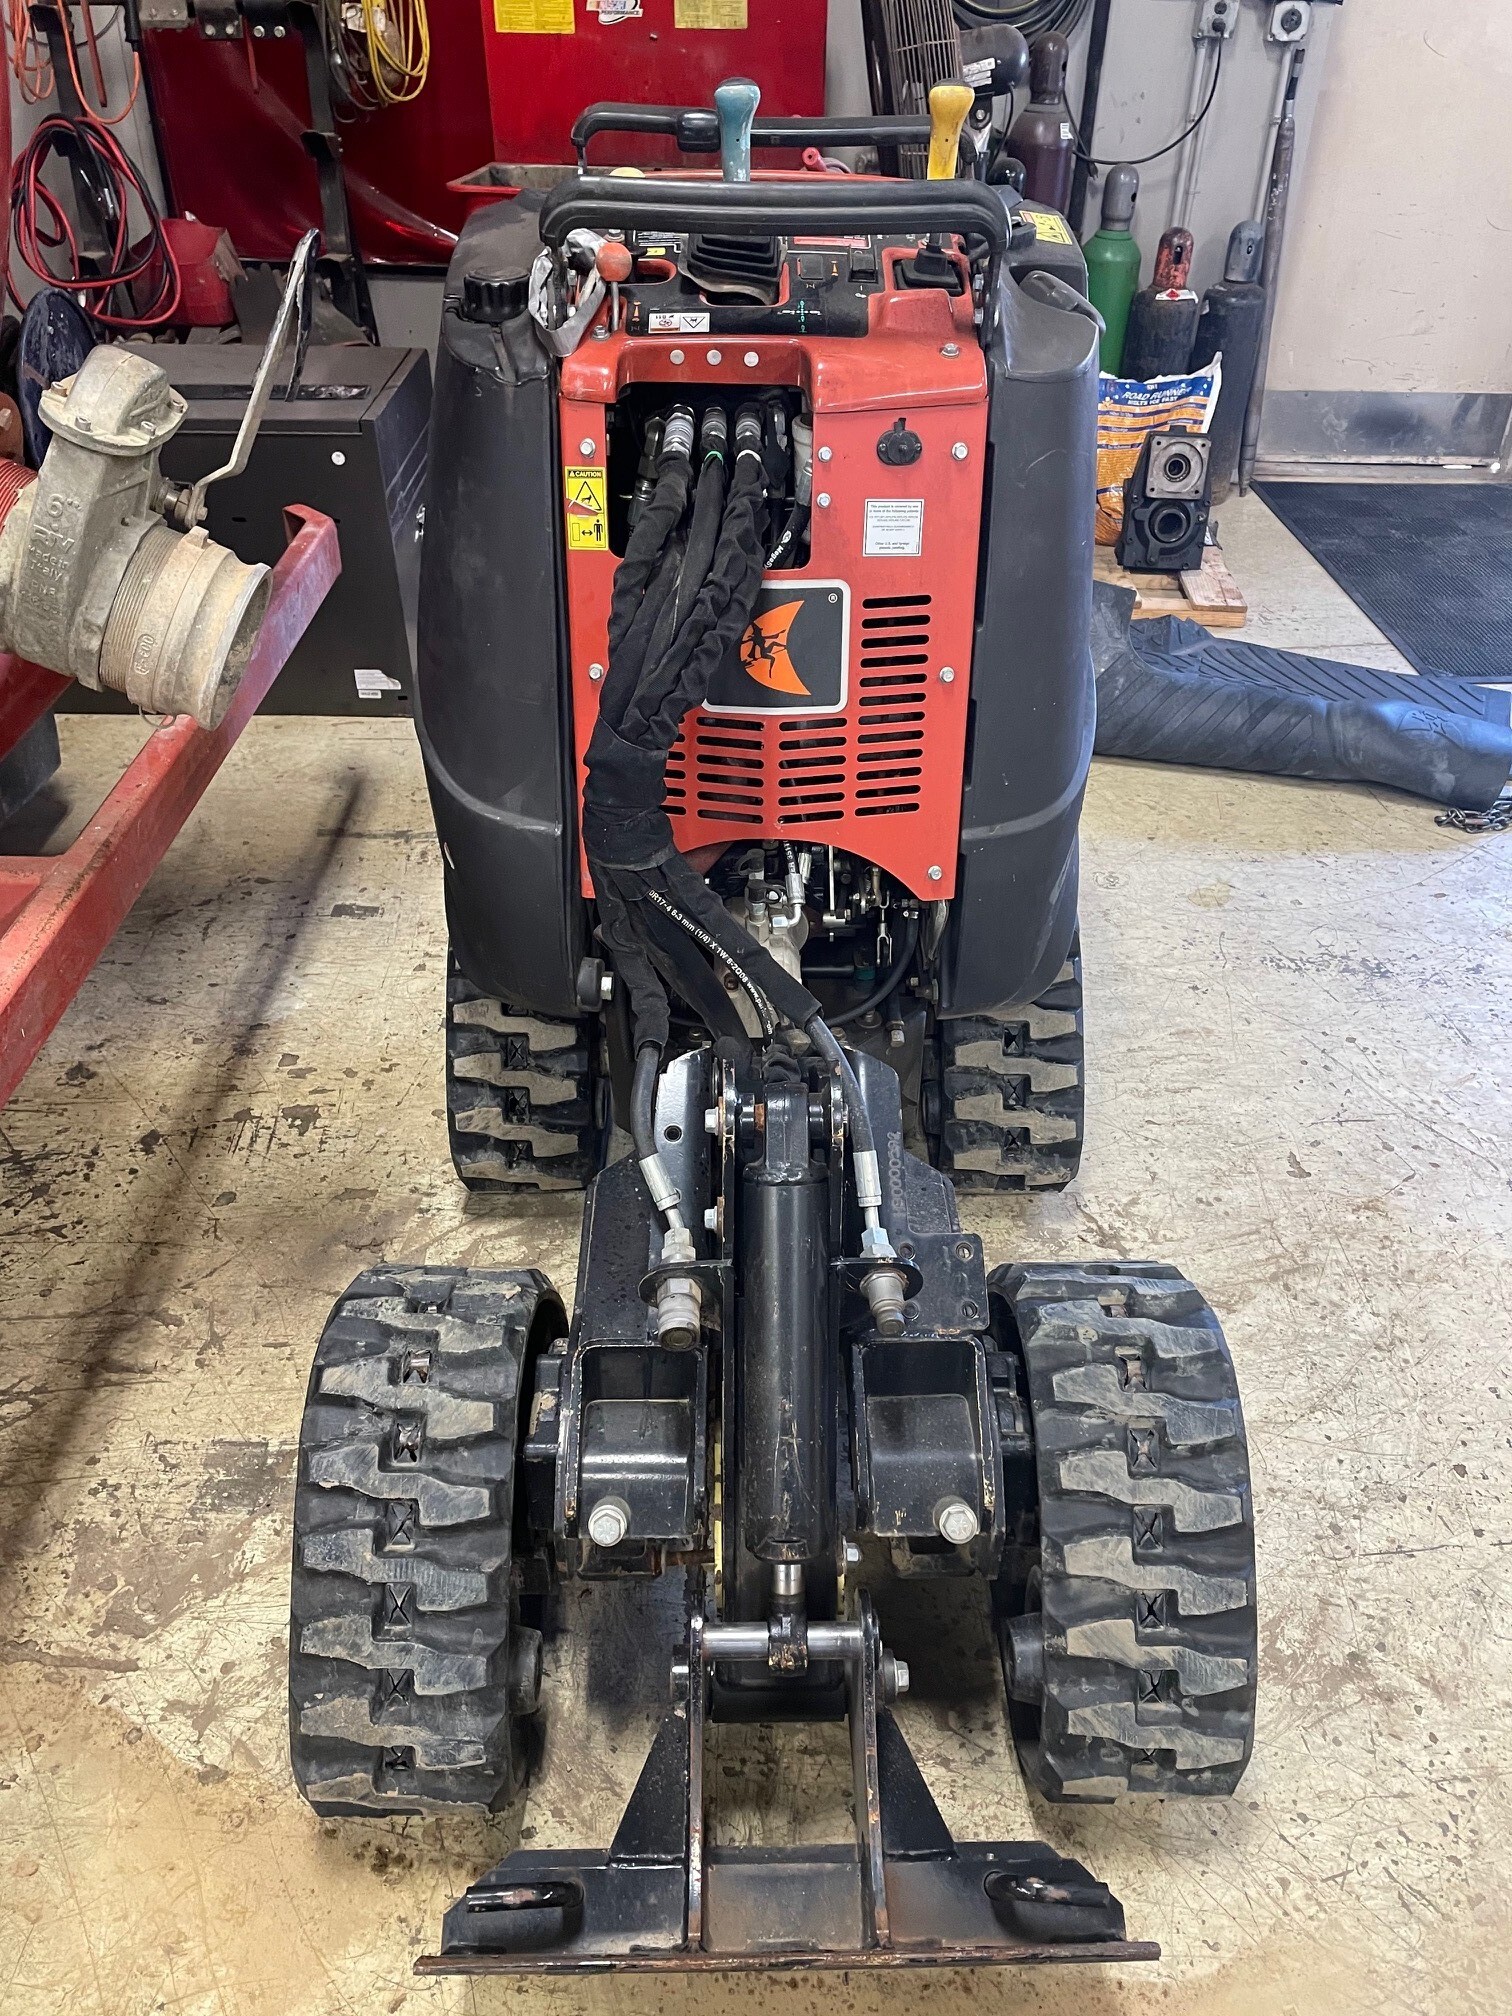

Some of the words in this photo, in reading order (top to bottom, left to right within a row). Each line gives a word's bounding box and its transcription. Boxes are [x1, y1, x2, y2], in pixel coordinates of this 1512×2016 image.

[1122, 391, 1150, 400] ROAD
[671, 908, 683, 921] 6.3
[681, 918, 695, 932] mm
[695, 928, 711, 944] (1/4)
[709, 941, 717, 950] X
[716, 947, 729, 962] 1W
